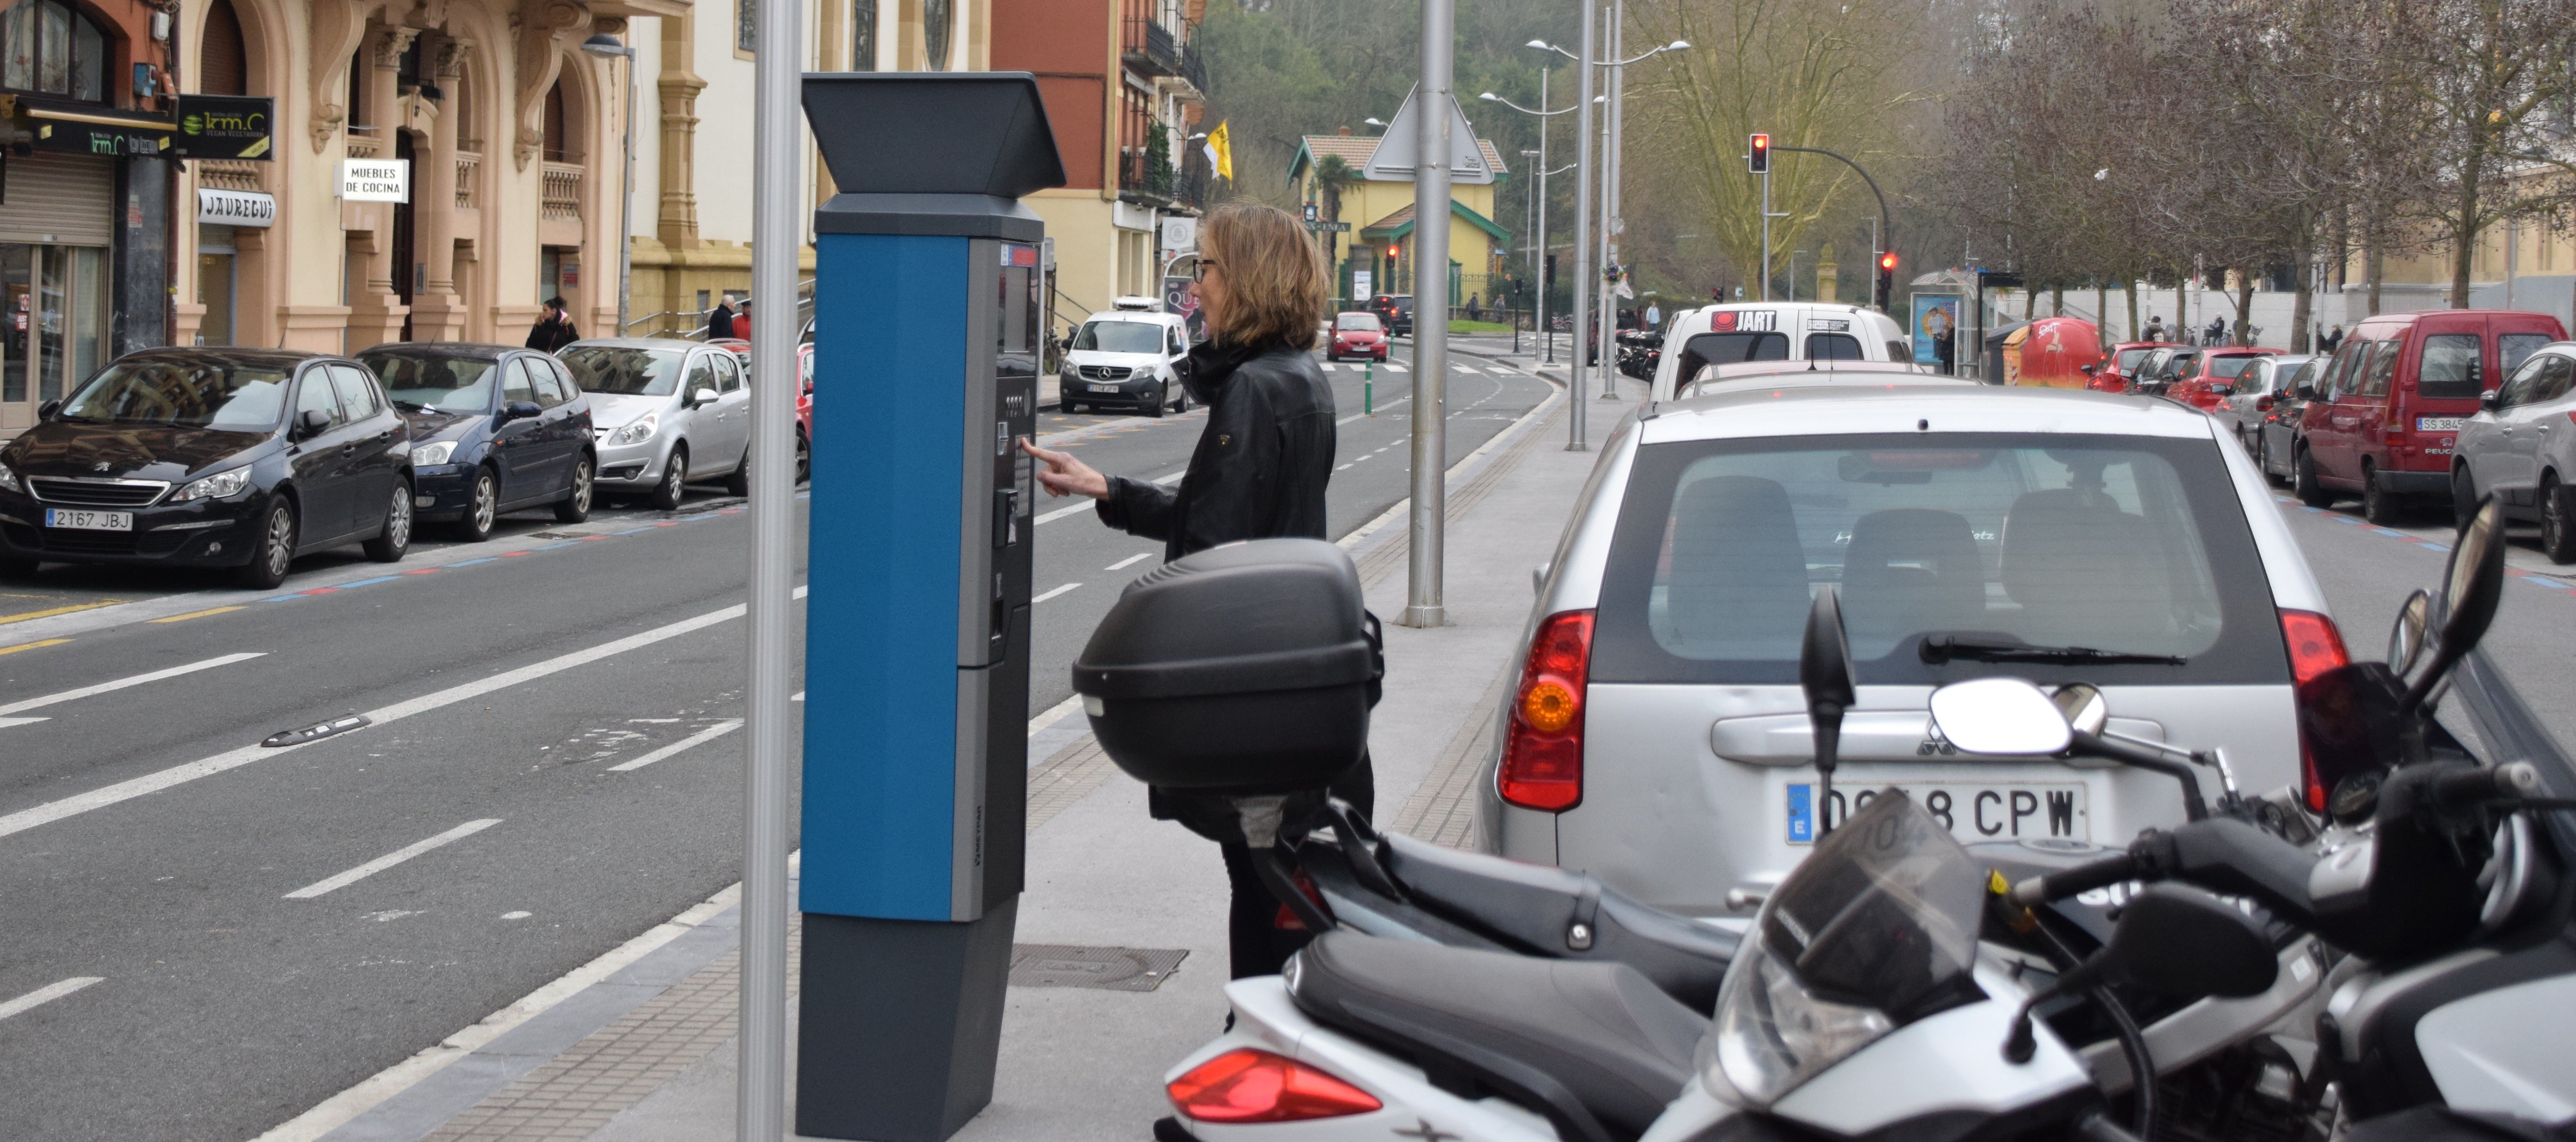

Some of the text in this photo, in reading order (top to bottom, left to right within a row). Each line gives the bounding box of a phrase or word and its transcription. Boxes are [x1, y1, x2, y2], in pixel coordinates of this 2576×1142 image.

[351, 168, 396, 179] MUEBLES
[346, 182, 399, 193] DE COCINA
[1736, 311, 1775, 332] JART
[2424, 420, 2437, 429] SS
[57, 512, 128, 528] 2167 JBJ
[1971, 530, 1994, 540] etz
[1974, 790, 2073, 837] CPW
[1795, 820, 1805, 834] E
